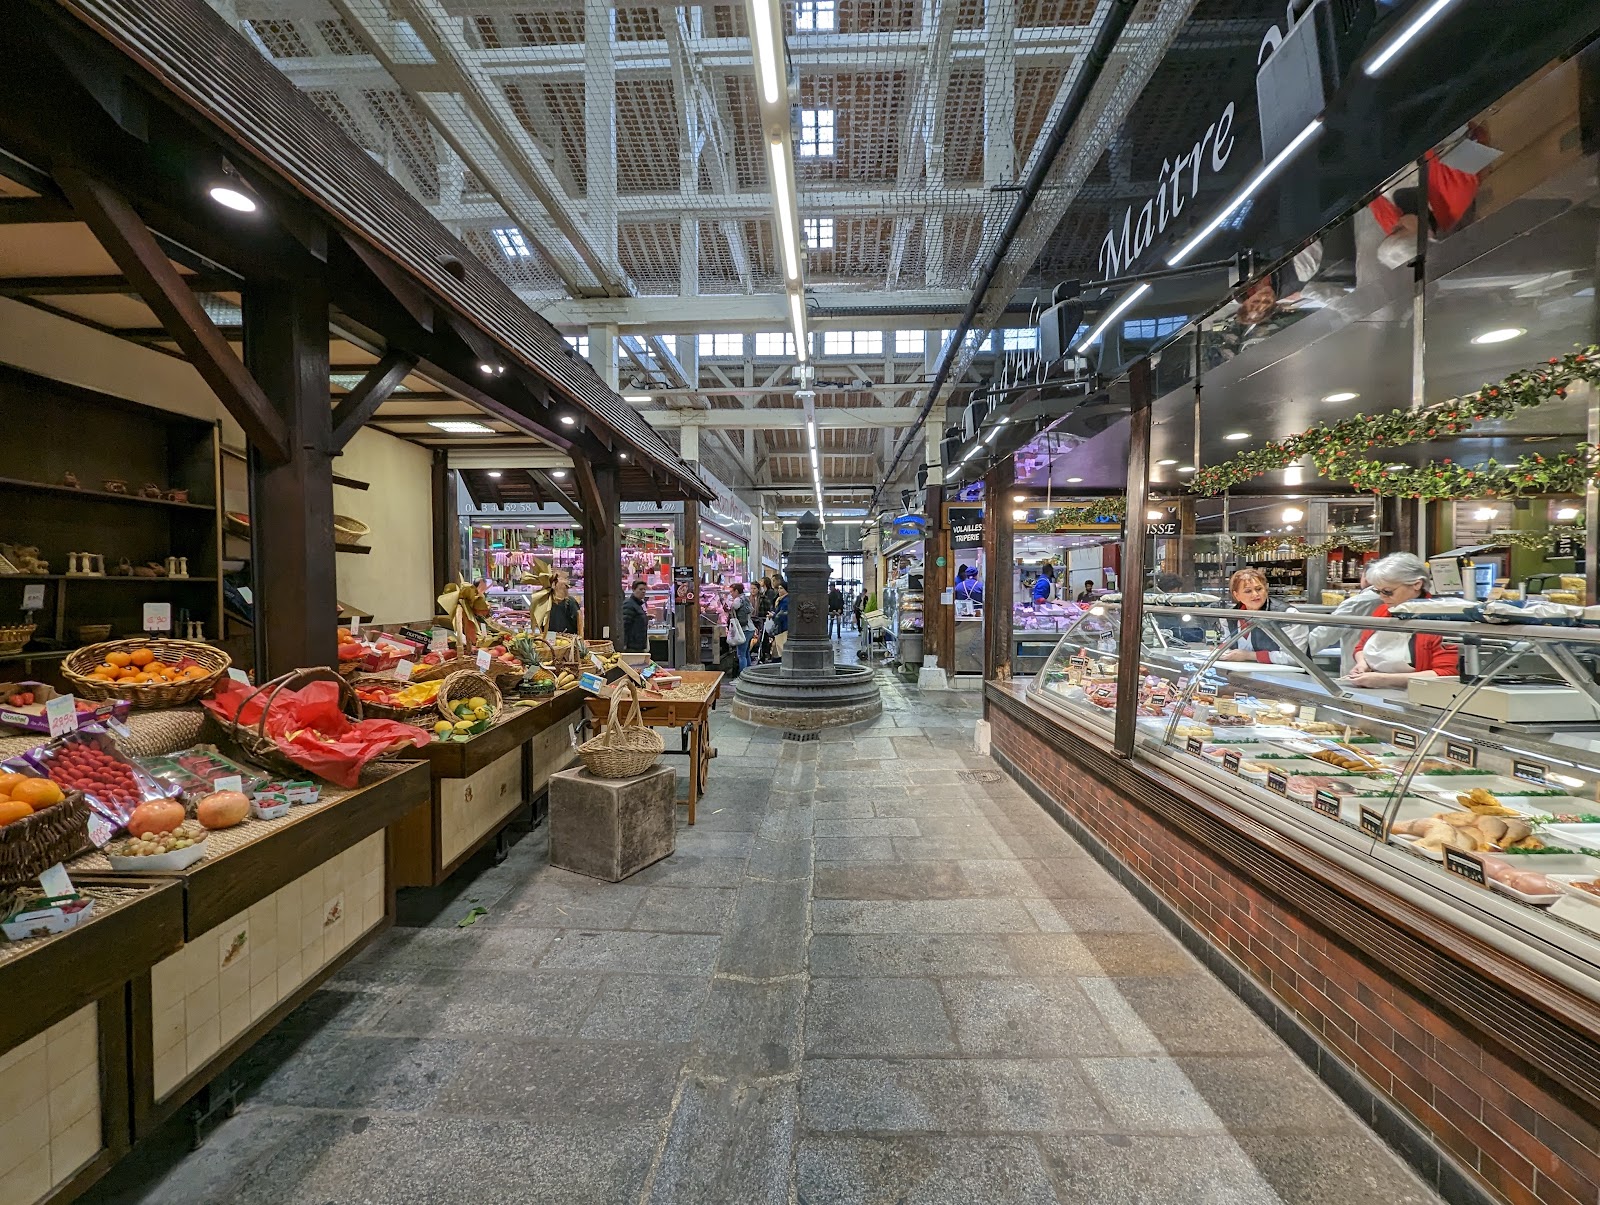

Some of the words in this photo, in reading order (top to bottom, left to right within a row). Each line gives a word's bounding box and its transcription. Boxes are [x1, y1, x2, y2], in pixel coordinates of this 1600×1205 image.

[1087, 101, 1235, 294] Maître
[952, 523, 983, 534] VOLAILLES
[1146, 523, 1176, 535] ISSE
[955, 533, 980, 543] TRIPERIE
